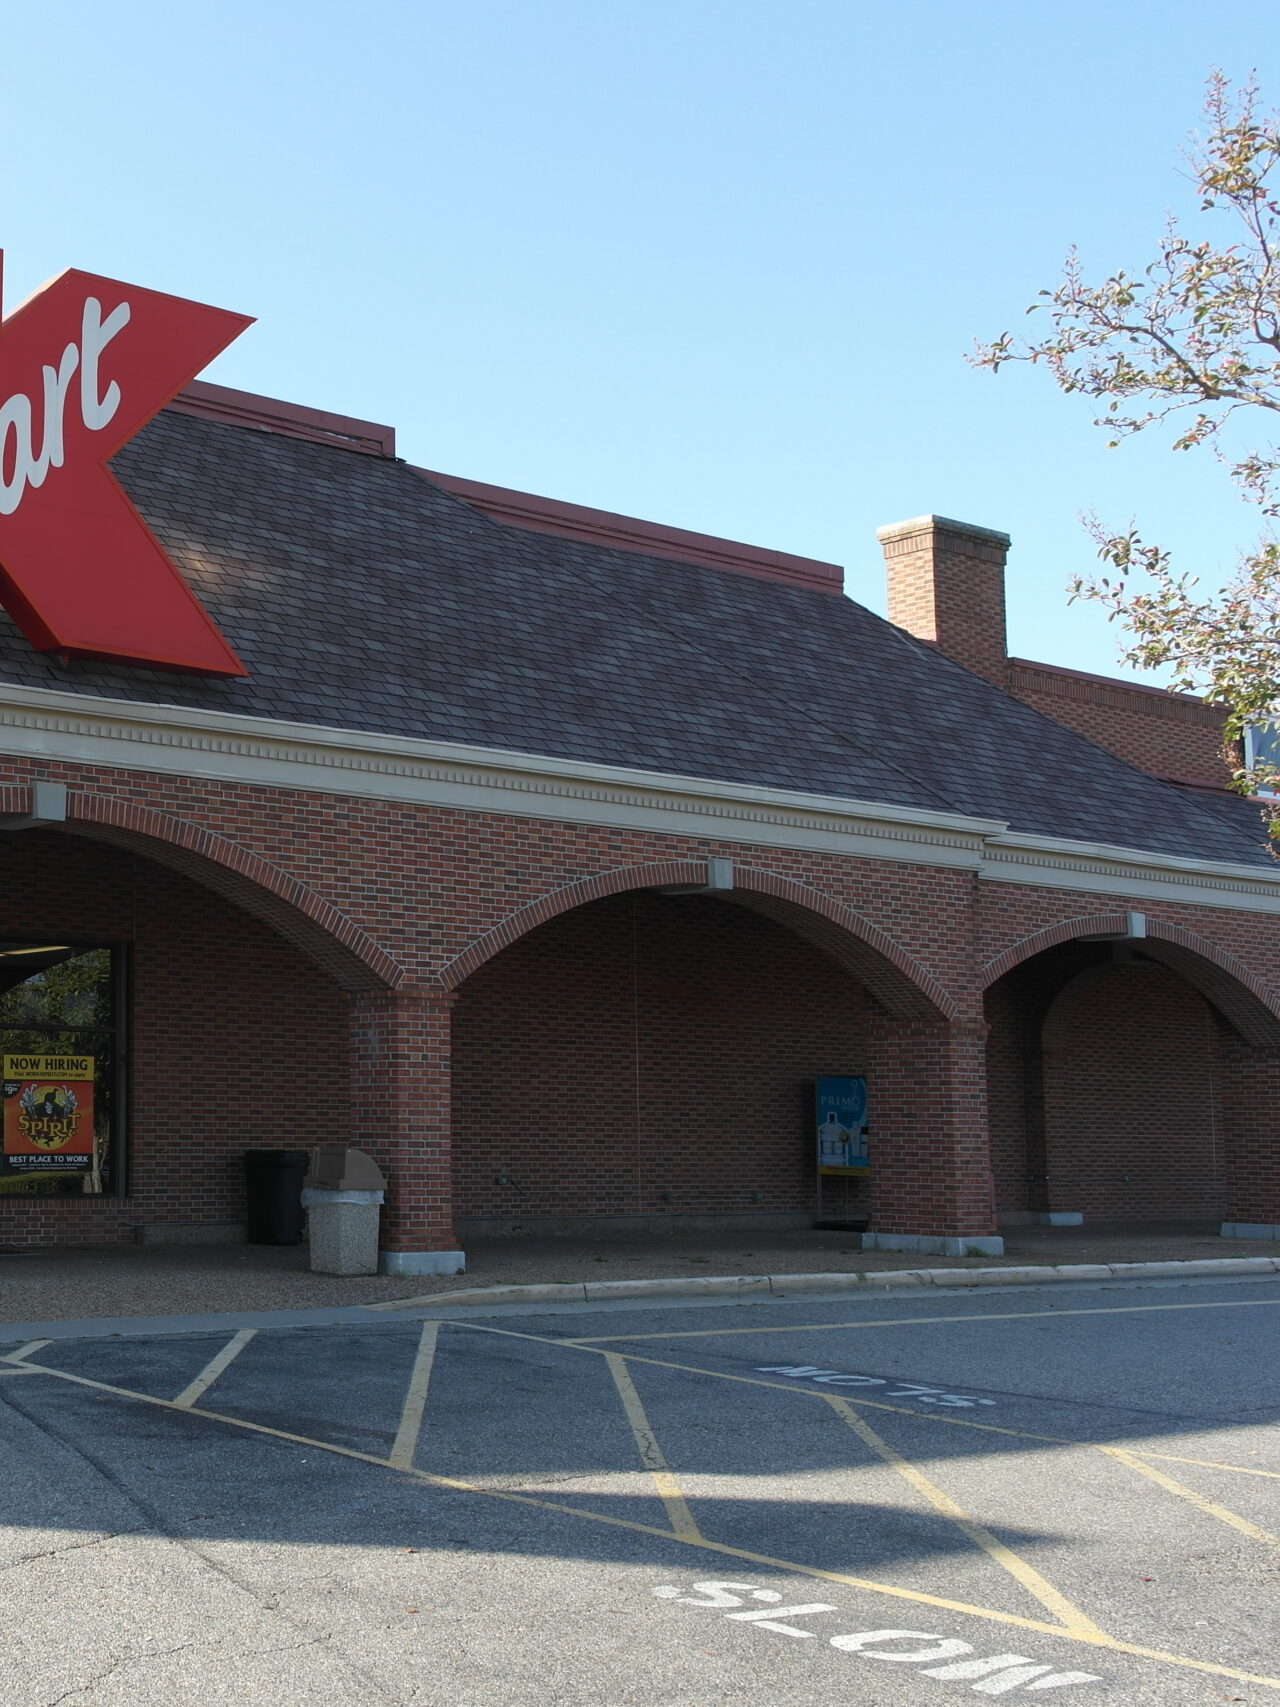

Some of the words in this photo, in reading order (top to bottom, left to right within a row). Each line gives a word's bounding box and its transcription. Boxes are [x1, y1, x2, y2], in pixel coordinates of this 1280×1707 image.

[10, 1058, 41, 1070] NOW
[45, 1059, 88, 1071] HIRING
[821, 1095, 861, 1106] PRIMO
[18, 1113, 81, 1138] SPIRIT
[755, 1364, 997, 1408] SLOW
[650, 1580, 1104, 1695] SLOW
